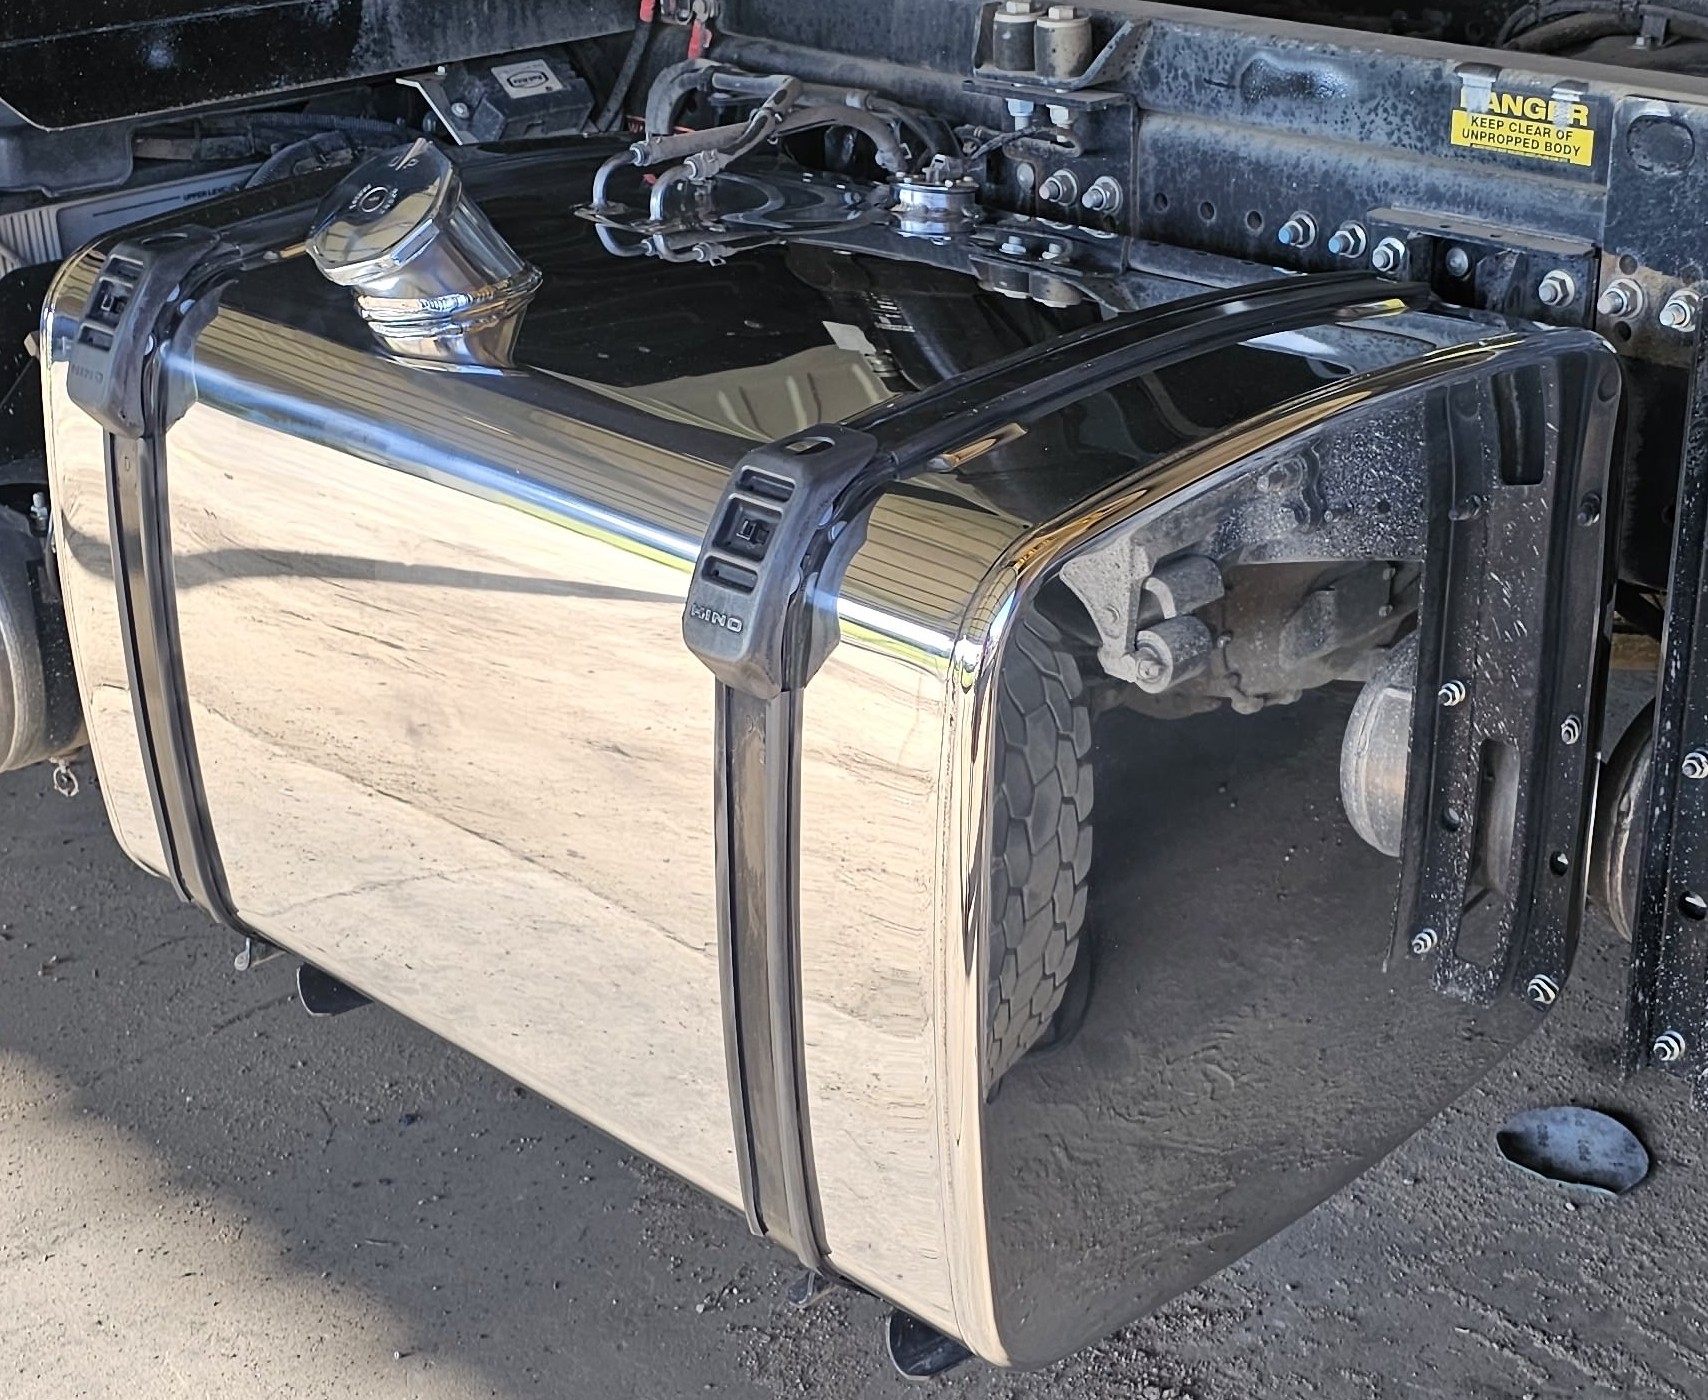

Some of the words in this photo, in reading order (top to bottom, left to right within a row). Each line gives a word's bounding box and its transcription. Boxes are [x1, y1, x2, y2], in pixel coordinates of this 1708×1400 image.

[1462, 128, 1540, 151] UNPROPPED
[1544, 141, 1581, 156] BODY
[1471, 115, 1504, 130] KEEP
[1509, 122, 1551, 139] CLEAR
[1556, 130, 1574, 142] OF
[690, 602, 743, 633] HINO
